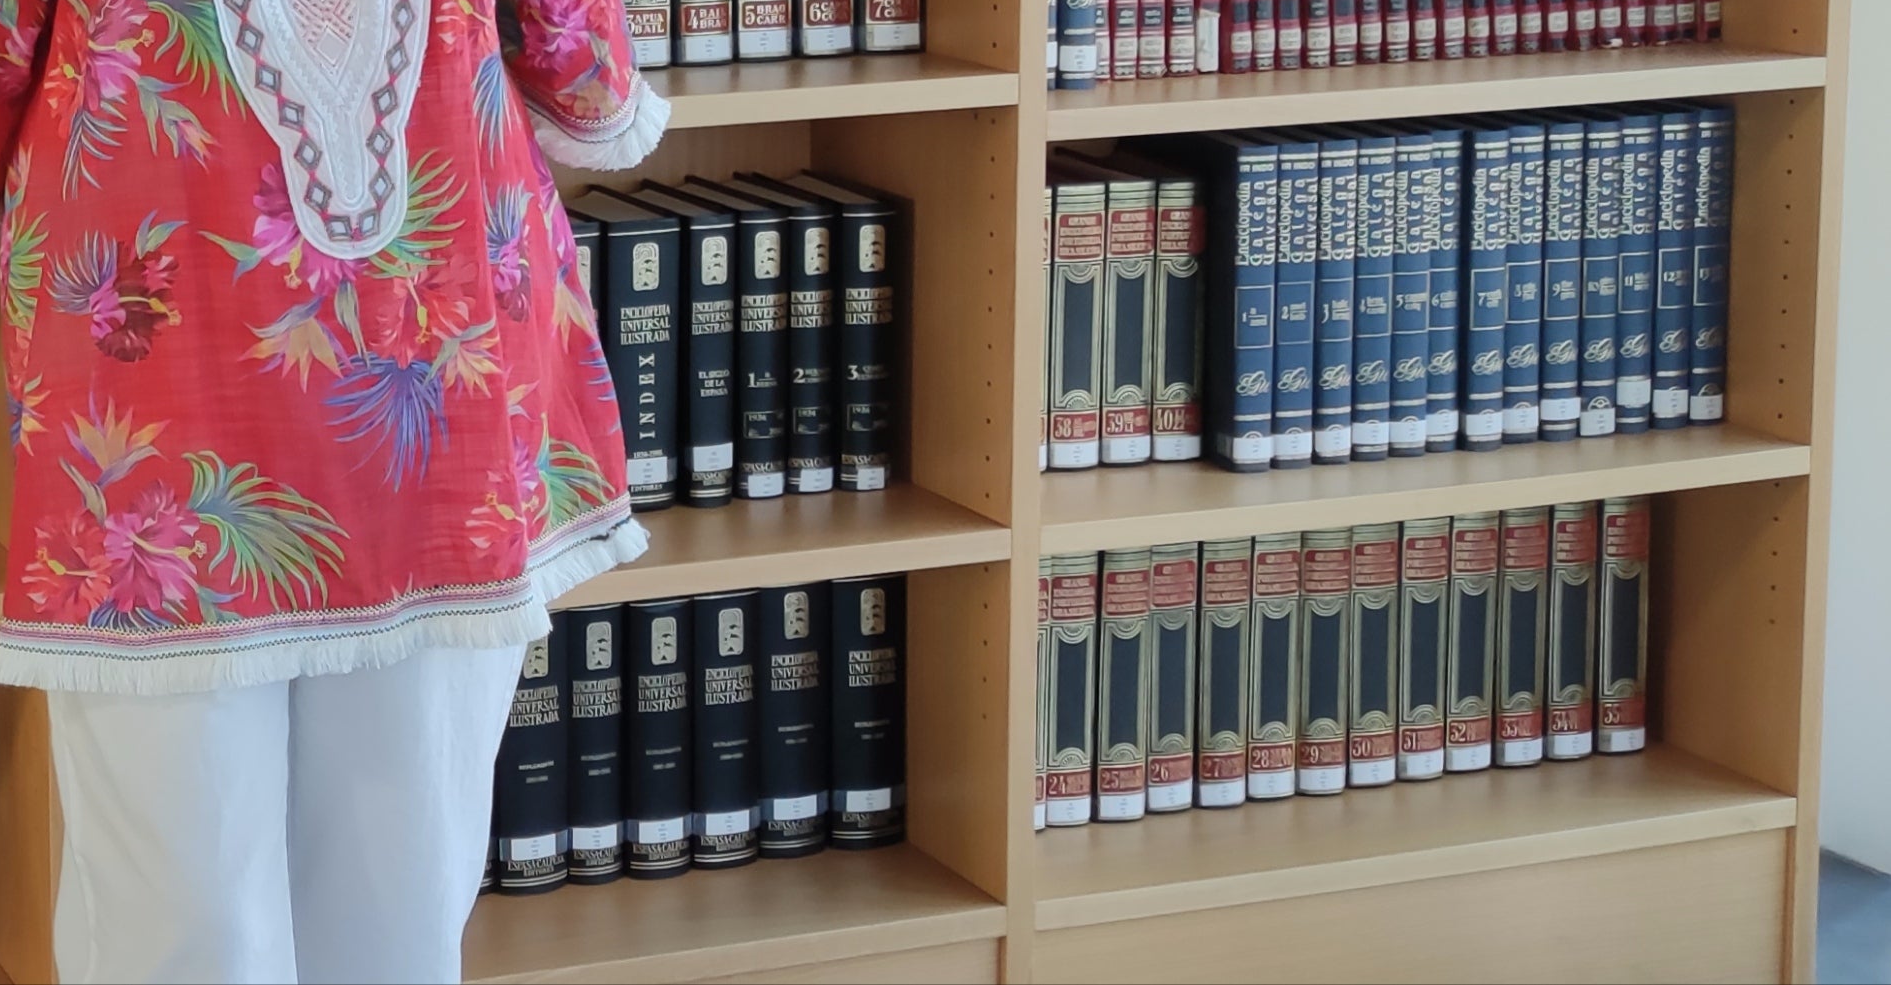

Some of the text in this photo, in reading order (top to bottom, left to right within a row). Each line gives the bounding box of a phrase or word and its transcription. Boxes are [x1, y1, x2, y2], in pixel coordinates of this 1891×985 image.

[688, 10, 699, 29] 4
[745, 6, 755, 25] 5
[809, 2, 821, 22] 6
